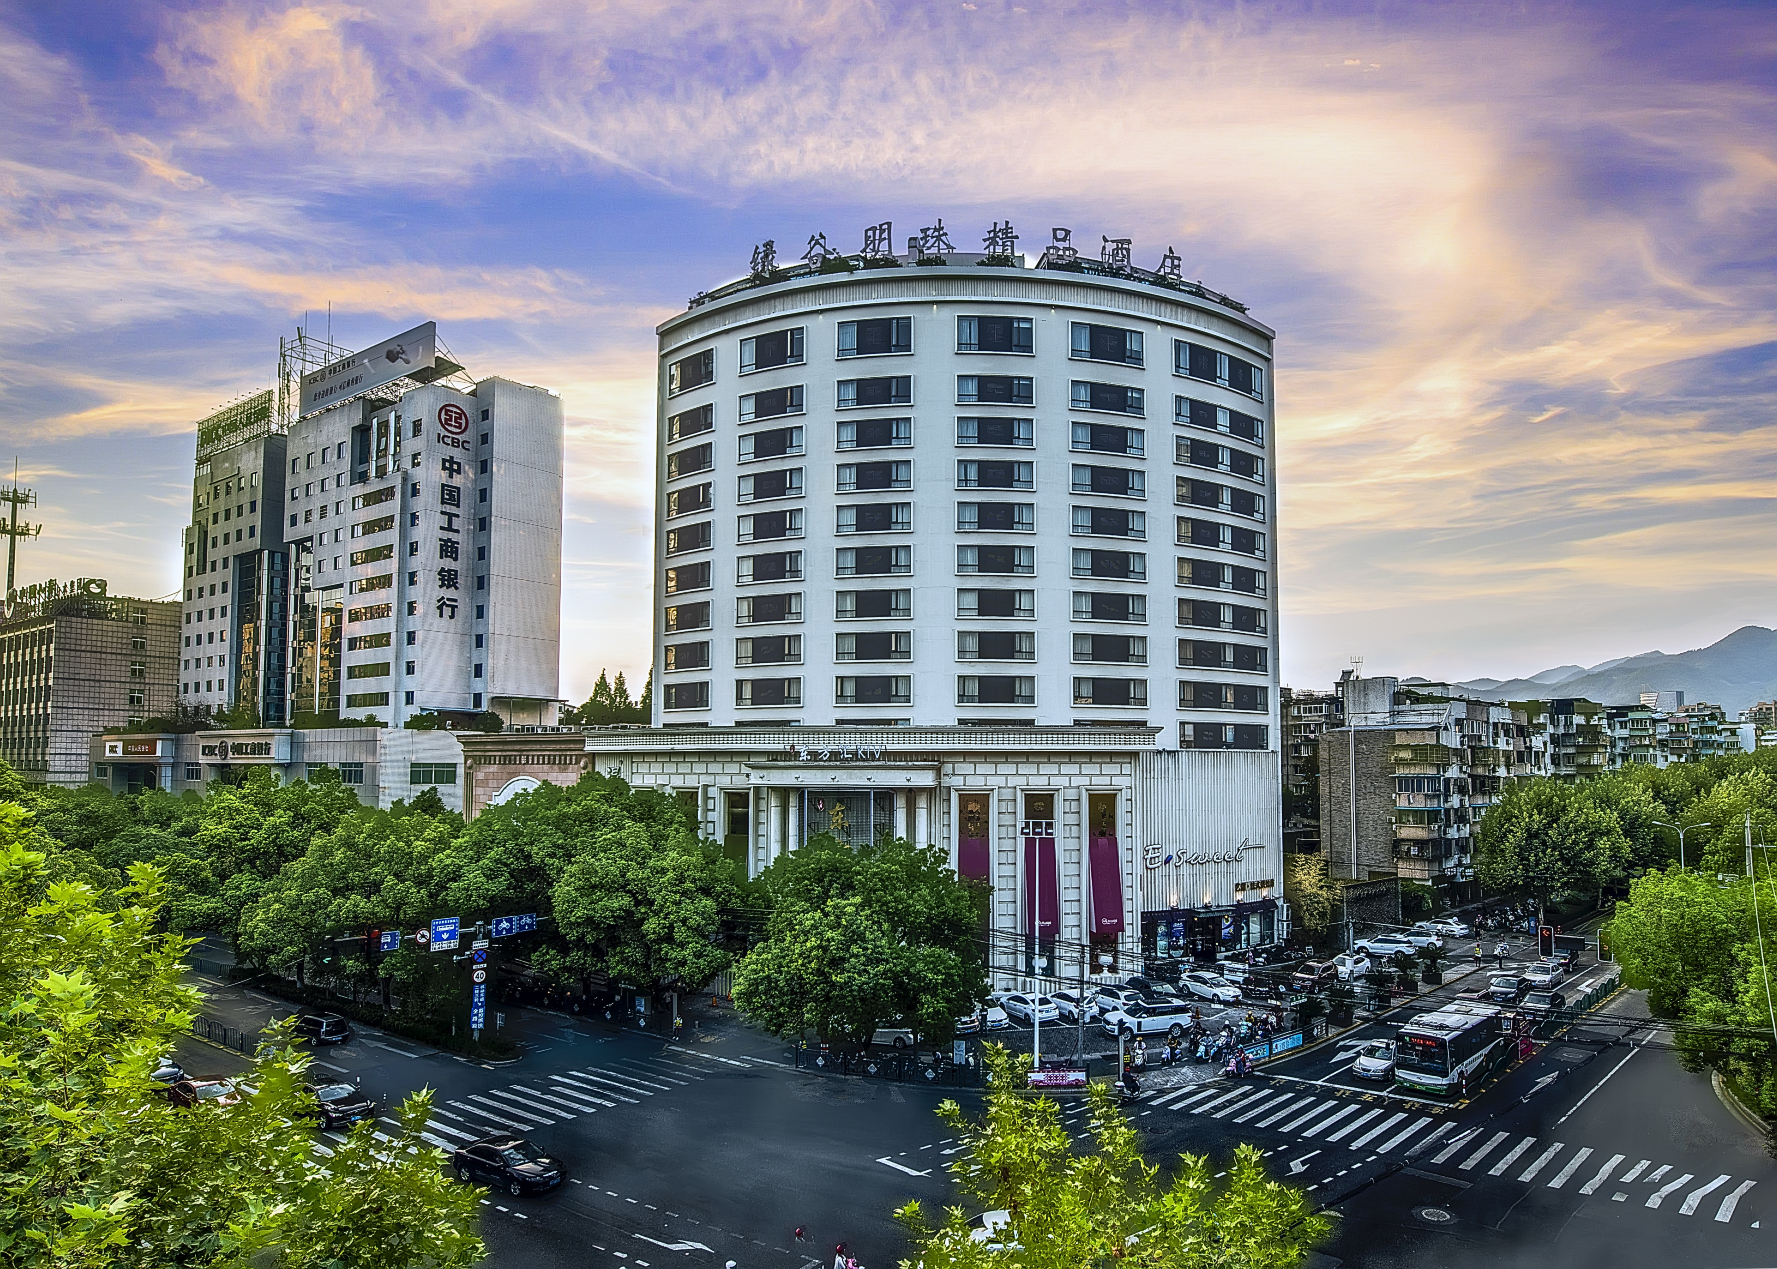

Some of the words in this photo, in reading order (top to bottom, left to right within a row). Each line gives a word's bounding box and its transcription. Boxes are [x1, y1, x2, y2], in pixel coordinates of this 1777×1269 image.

[437, 433, 471, 451] ICBC
[436, 455, 462, 620] 中国工商银行
[230, 741, 272, 756] 中国工商银行
[474, 972, 485, 980] 40
